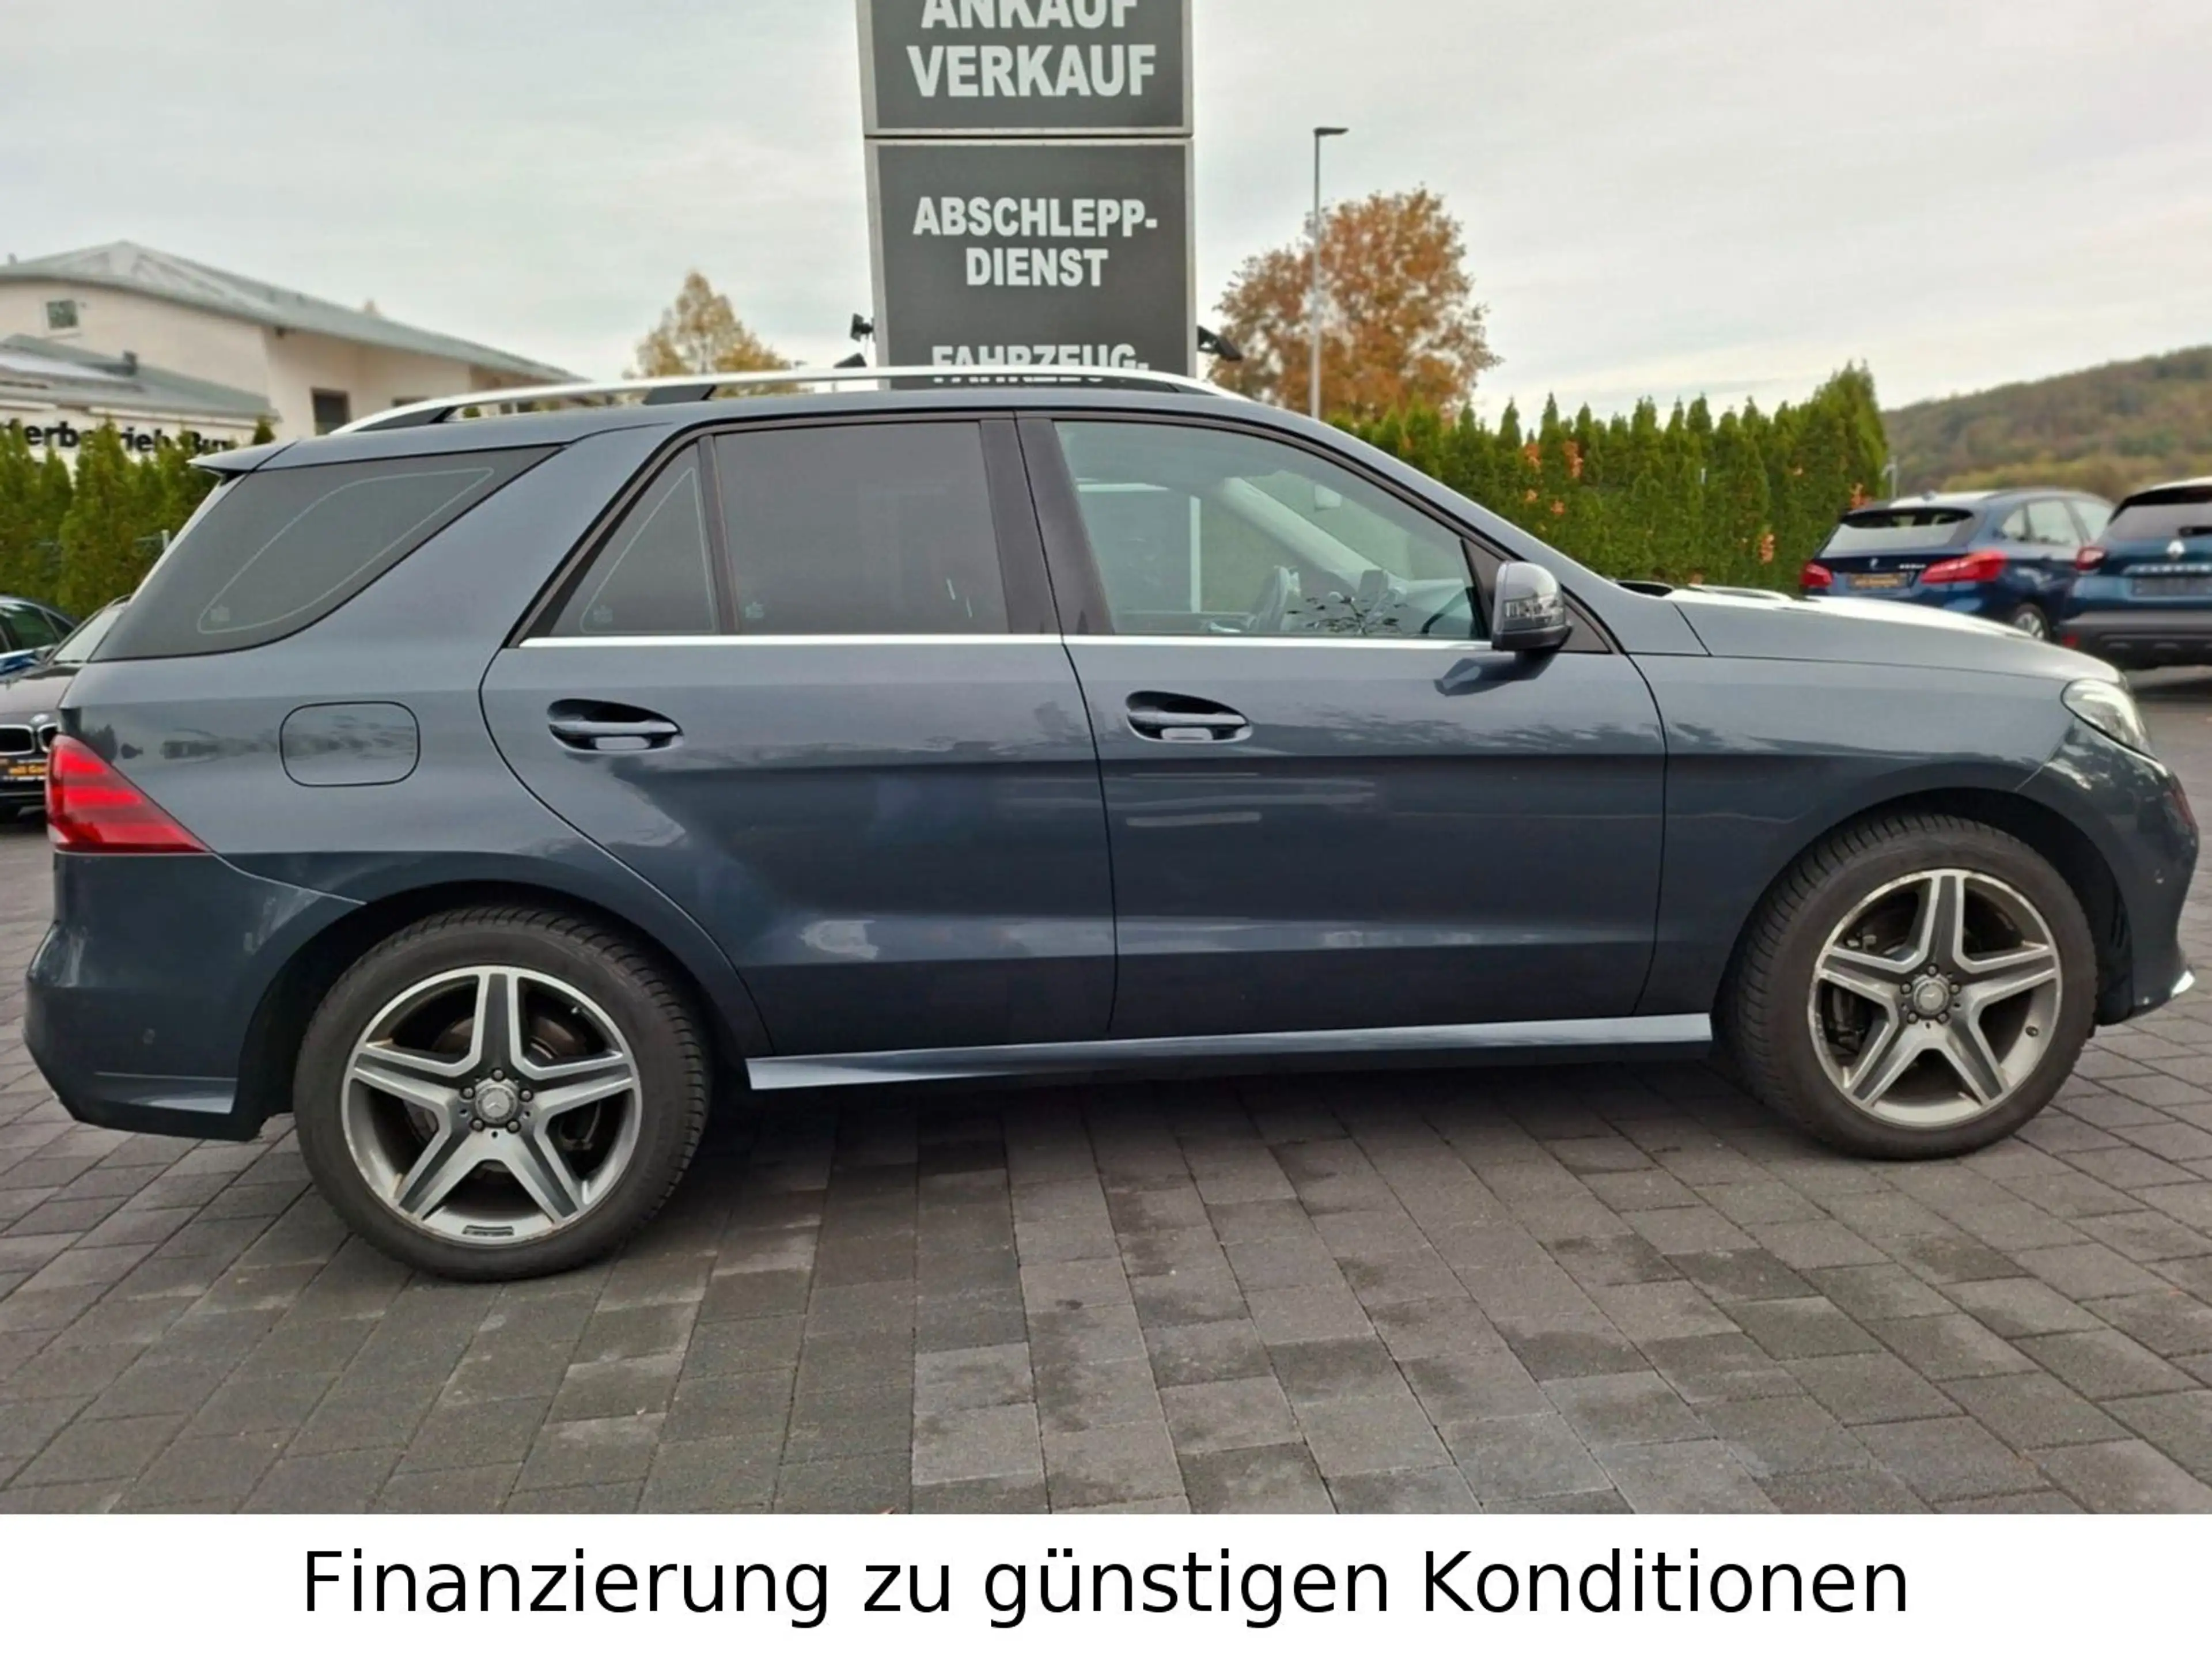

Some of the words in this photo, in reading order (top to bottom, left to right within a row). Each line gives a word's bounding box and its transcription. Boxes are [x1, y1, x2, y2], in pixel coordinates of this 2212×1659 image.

[921, 0, 1138, 28] ANKAUF
[906, 44, 1156, 97] VERKAUF
[912, 196, 1158, 237] ABSCHLEPP-
[966, 248, 1108, 287] DIENST
